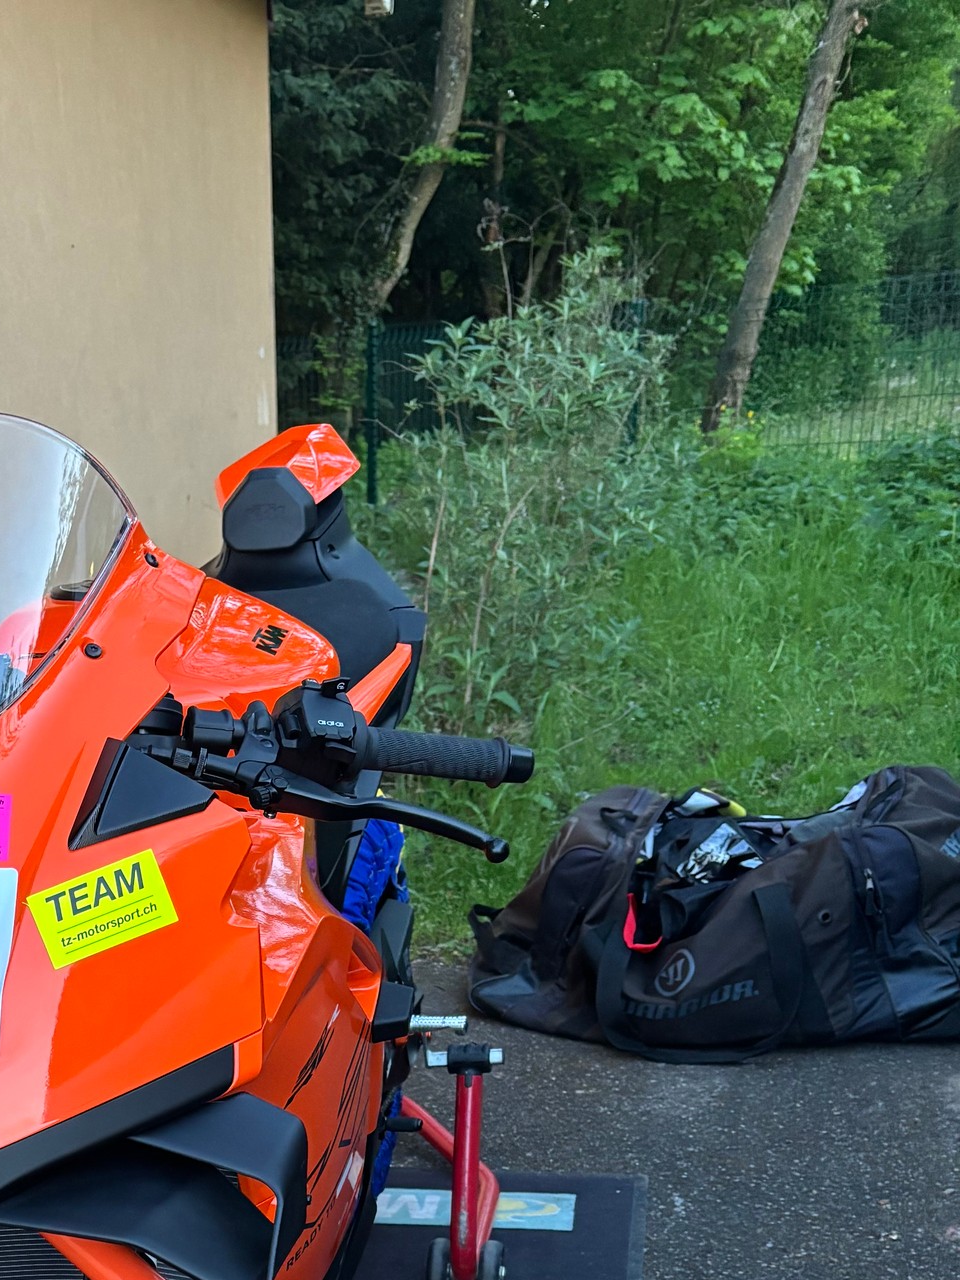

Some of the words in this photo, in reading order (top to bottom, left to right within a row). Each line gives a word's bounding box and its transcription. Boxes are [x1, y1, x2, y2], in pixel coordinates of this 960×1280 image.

[252, 624, 289, 656] KTM
[45, 862, 145, 922] TEAM
[61, 902, 157, 947] tz-motorsport.ch
[286, 1218, 323, 1271] READY
